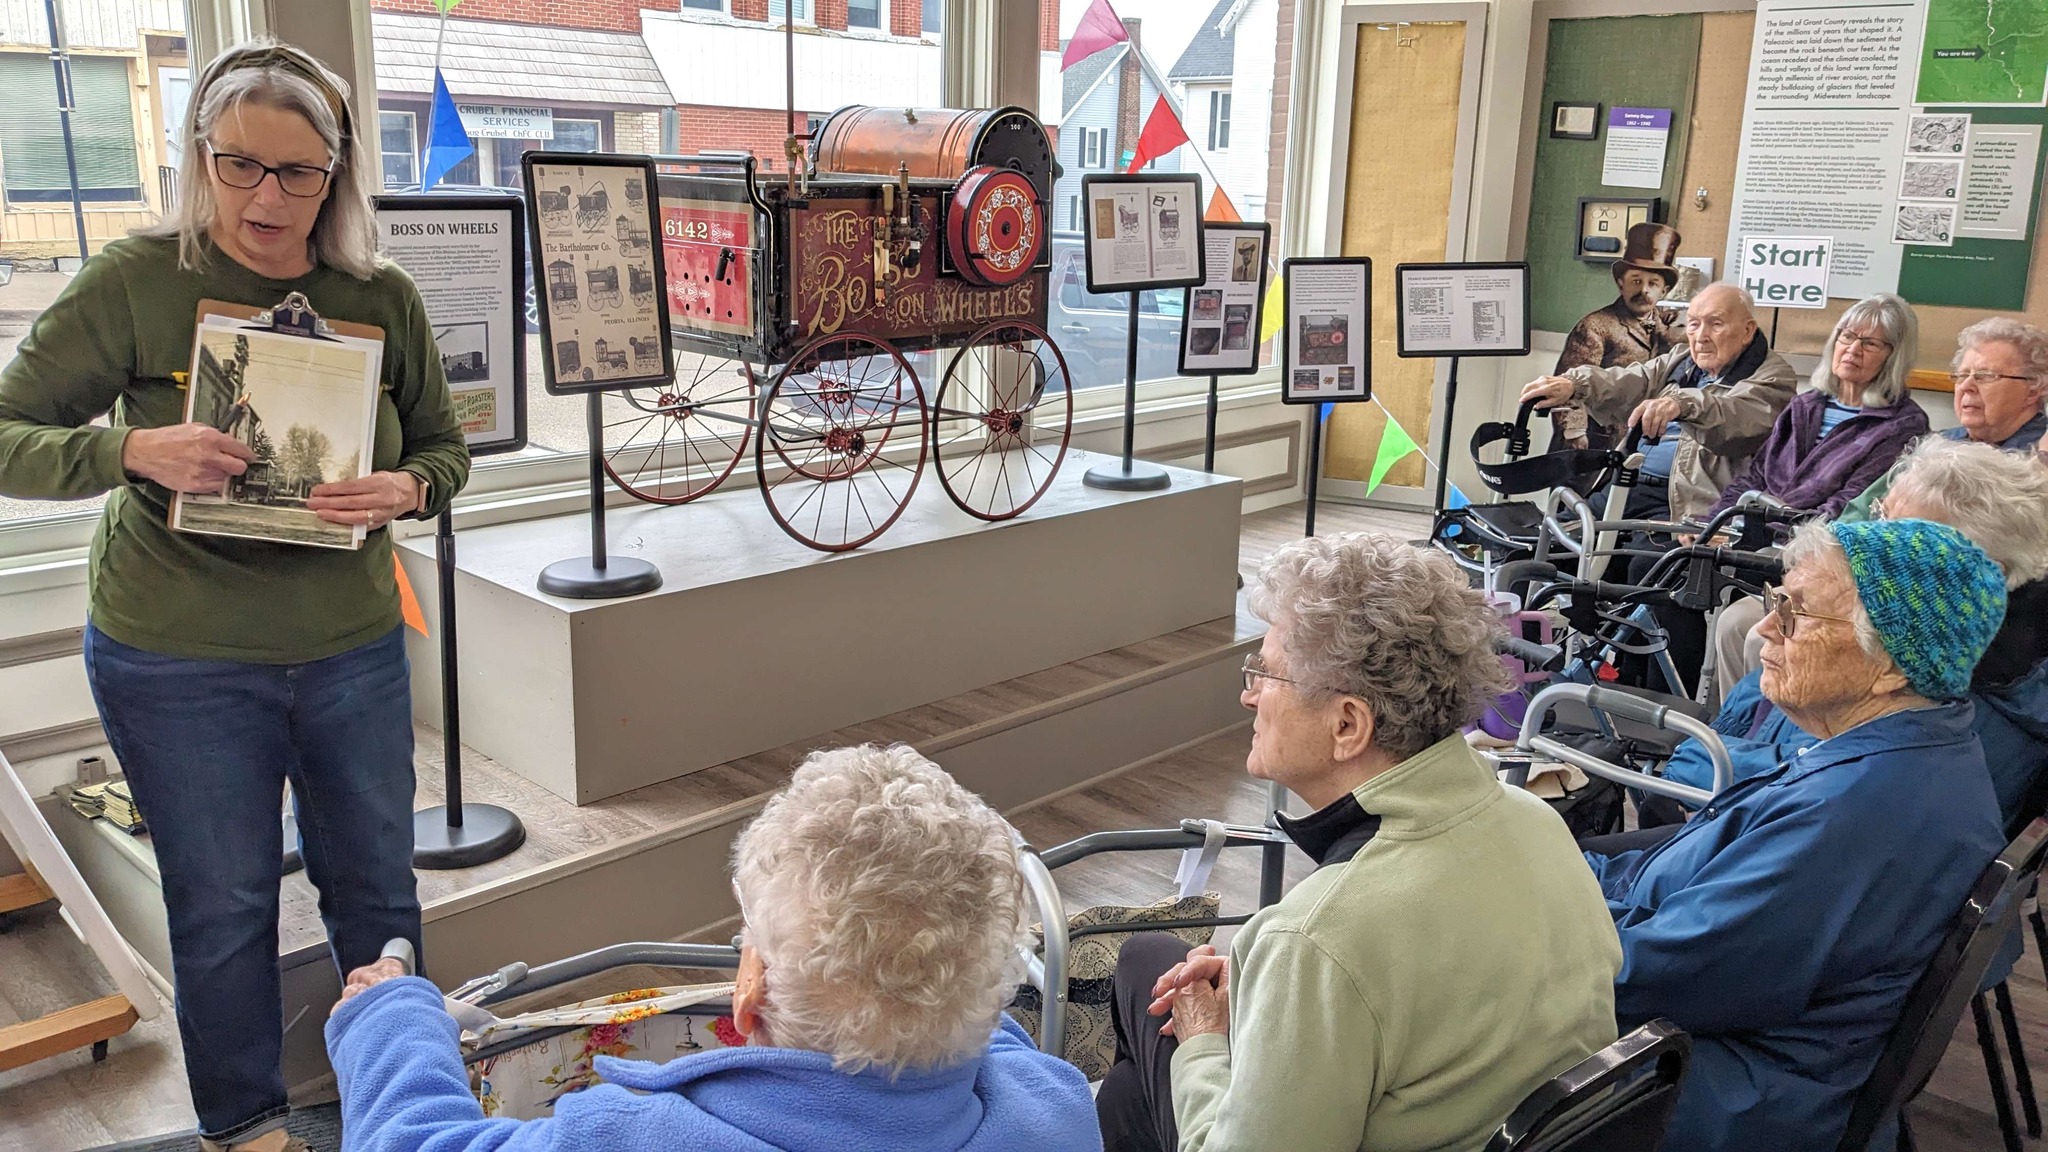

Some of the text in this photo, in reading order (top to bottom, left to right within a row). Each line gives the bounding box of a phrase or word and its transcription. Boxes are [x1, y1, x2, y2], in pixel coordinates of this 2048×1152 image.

[1789, 65, 1811, 73] valleys
[1781, 84, 1814, 92] bulldozing
[459, 106, 550, 117] CRUBEL FINANCIAL
[483, 117, 530, 127] SERVICES
[481, 129, 507, 137] Crubel
[391, 223, 498, 236] BOSS ON WHEELS
[665, 219, 708, 239] 6142
[823, 210, 859, 245] THE
[545, 242, 611, 252] The Bartholomew Co.
[1750, 244, 1826, 267] Start
[1745, 278, 1822, 302] Here
[898, 294, 925, 323] ON
